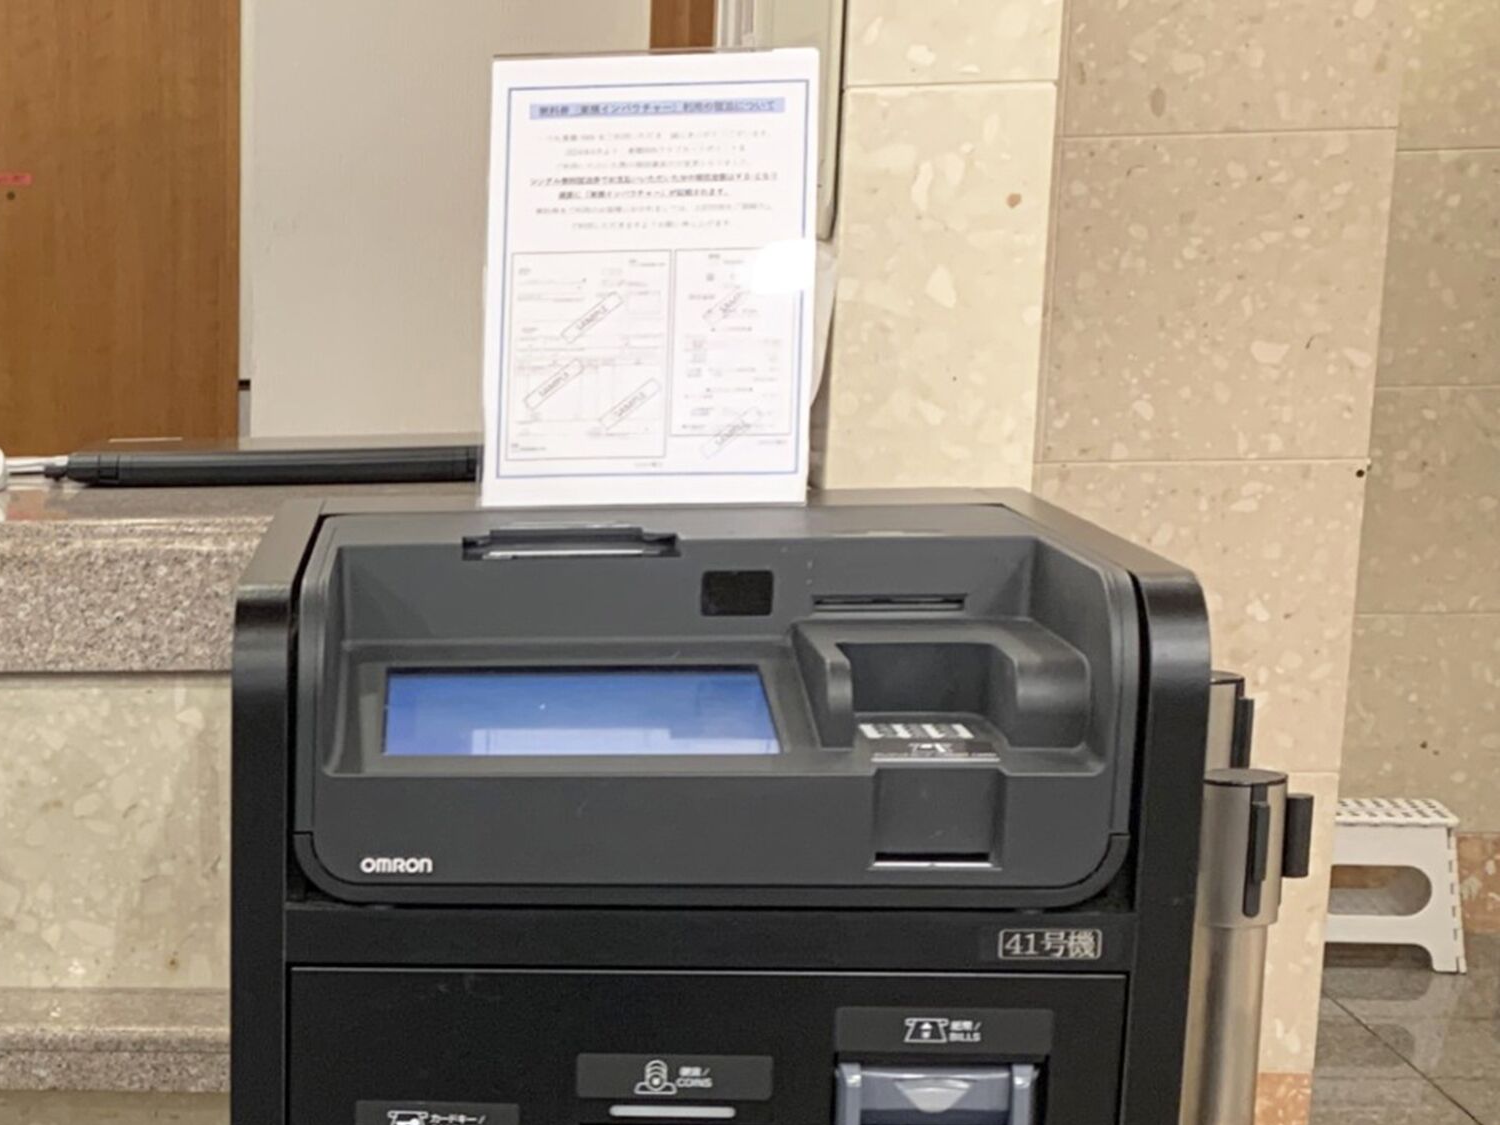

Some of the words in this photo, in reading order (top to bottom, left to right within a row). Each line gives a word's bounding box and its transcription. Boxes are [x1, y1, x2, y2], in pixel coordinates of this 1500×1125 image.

[360, 857, 433, 873] OMRON
[1004, 930, 1096, 958] 41号機
[949, 1031, 981, 1042] BILLS
[676, 1077, 713, 1088] COINS
